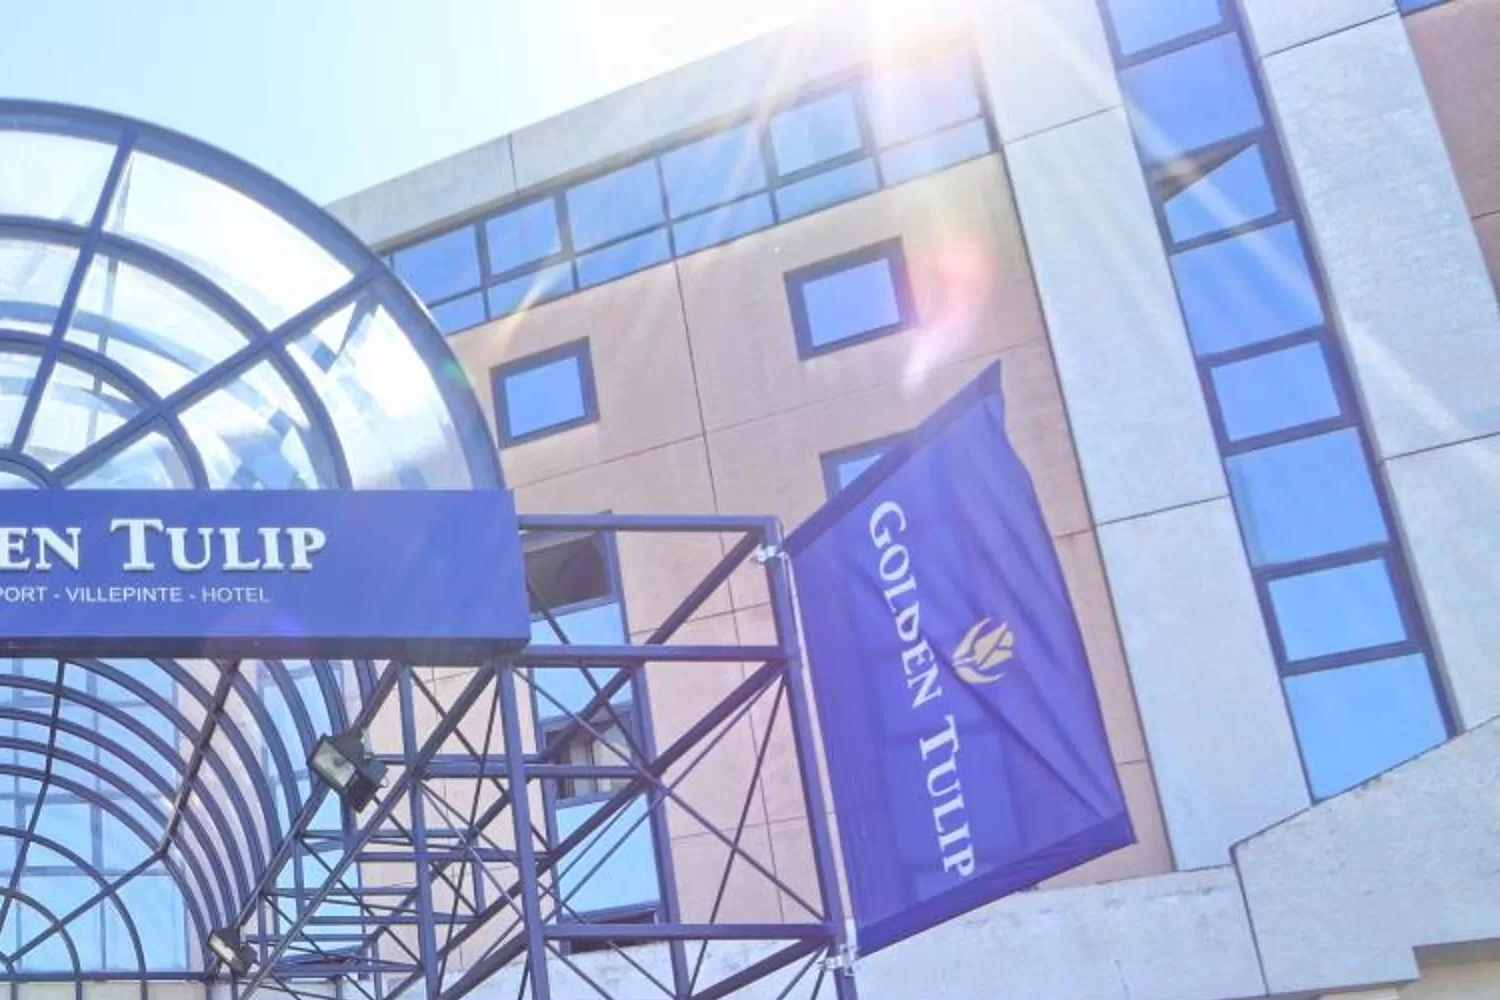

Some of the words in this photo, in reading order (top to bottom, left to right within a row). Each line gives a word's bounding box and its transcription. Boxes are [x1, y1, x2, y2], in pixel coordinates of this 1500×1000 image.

[110, 518, 327, 571] TULIP
[65, 586, 183, 602] VILLEPINTE
[202, 586, 270, 602] HOTEL
[869, 501, 942, 709] GOLDEN
[919, 716, 979, 878] TULIP
